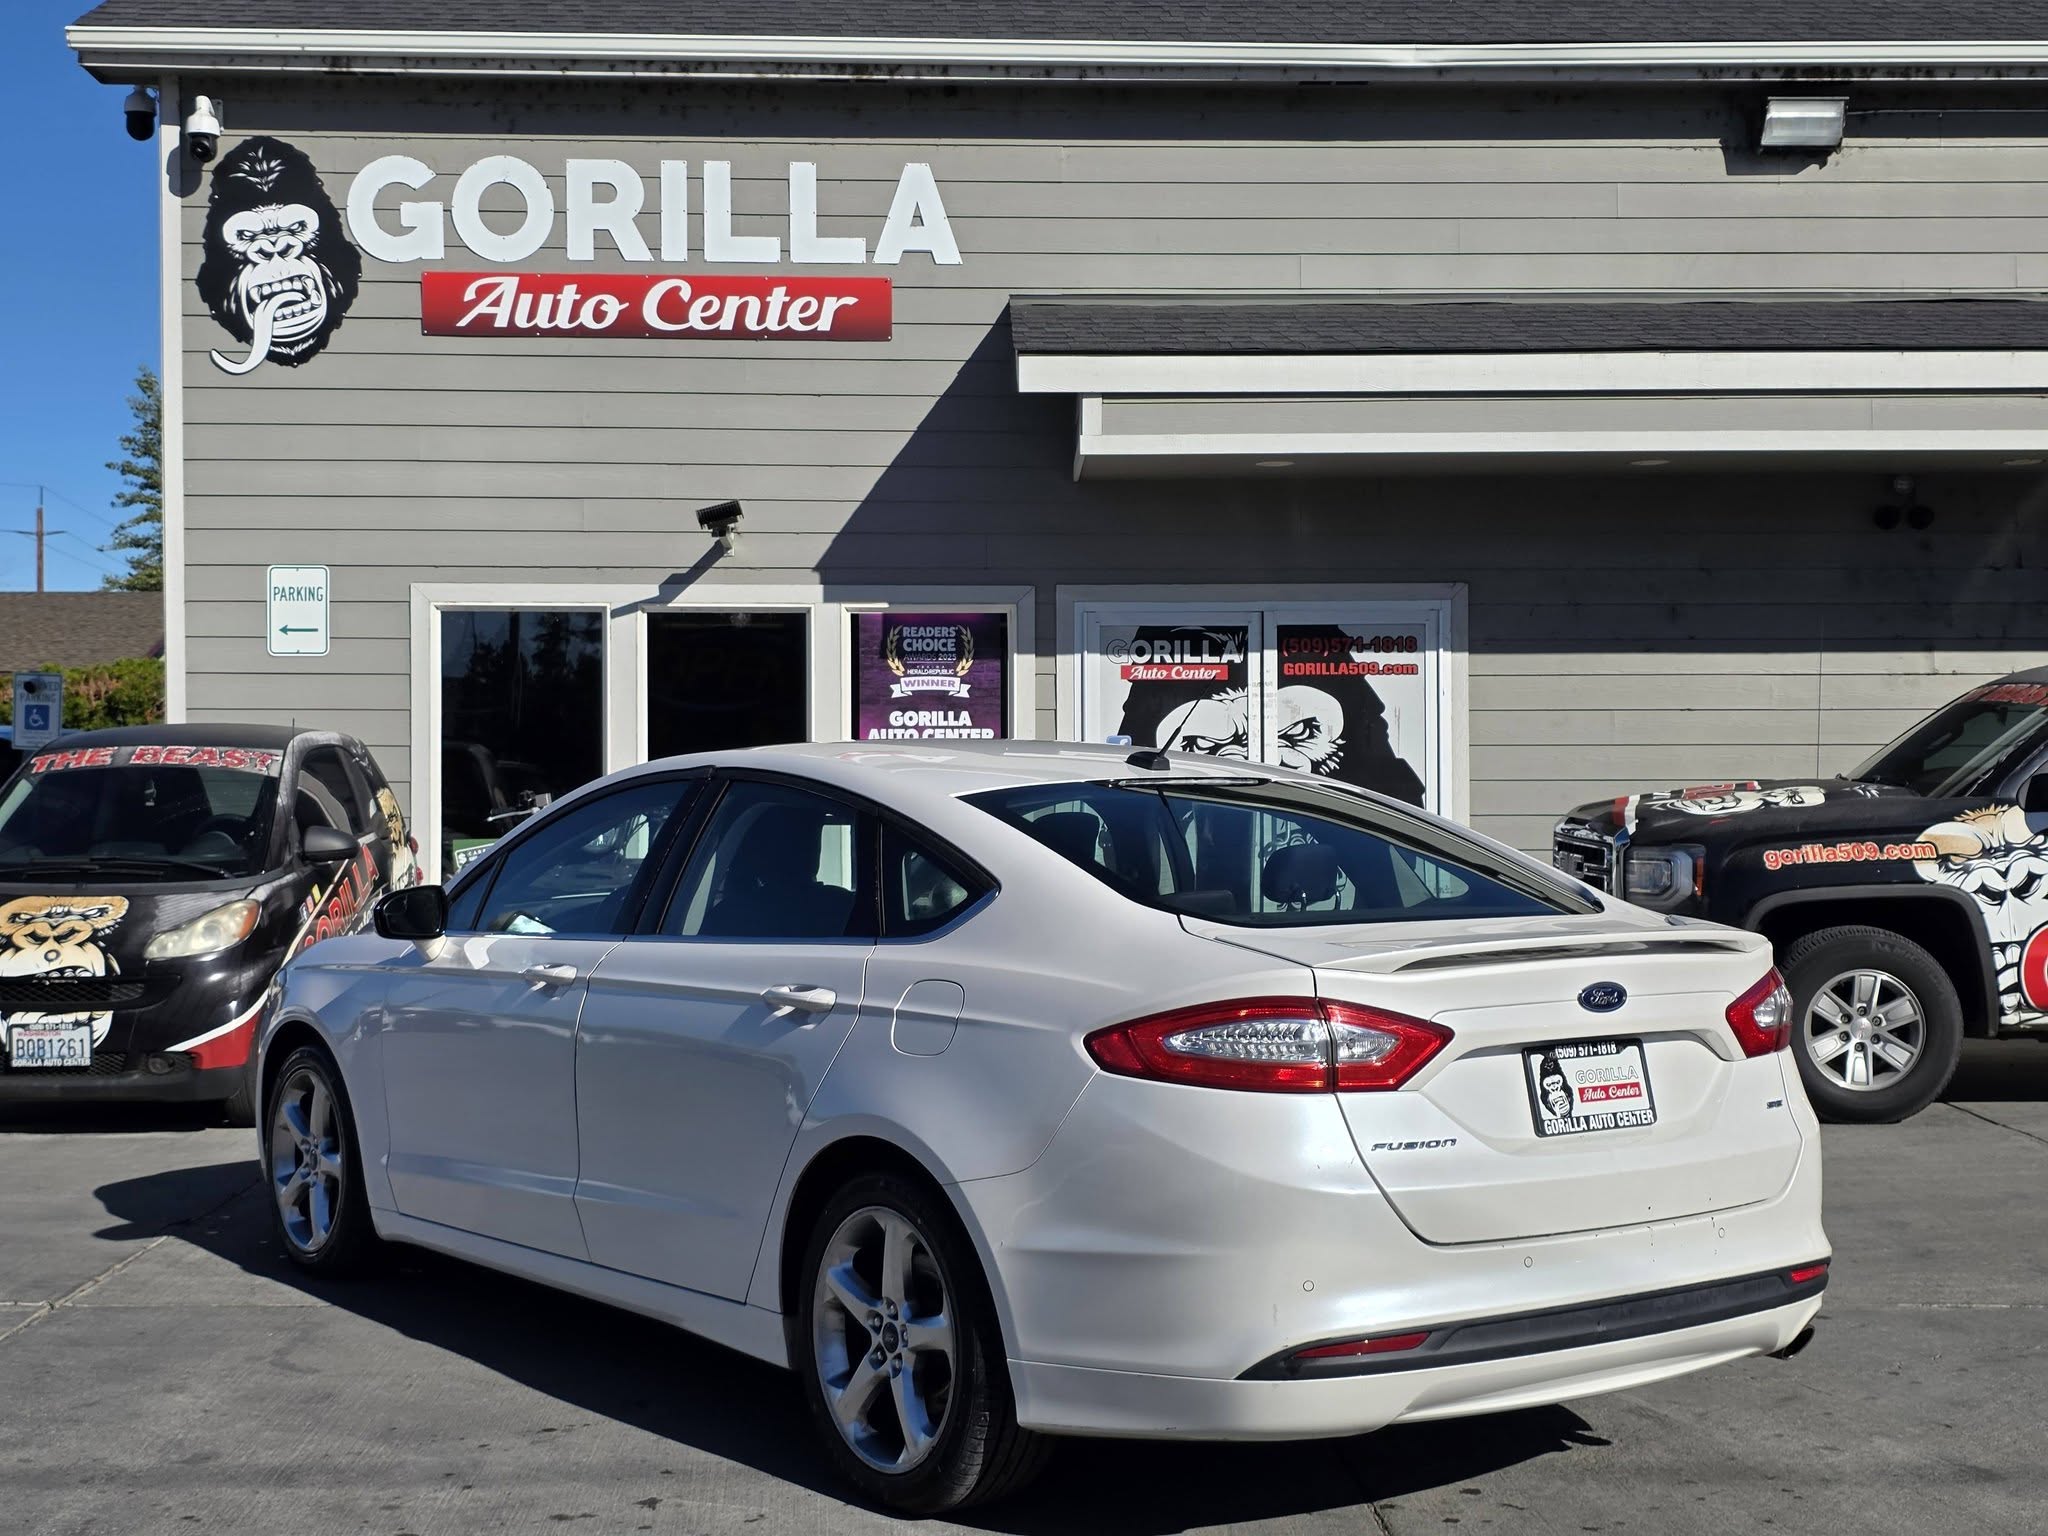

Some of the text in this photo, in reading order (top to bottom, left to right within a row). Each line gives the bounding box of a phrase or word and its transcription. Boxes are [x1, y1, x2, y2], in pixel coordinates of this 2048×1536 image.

[346, 155, 963, 265] GORILLA
[455, 275, 860, 333] Auto Center
[273, 586, 324, 602] PARKING
[903, 626, 958, 638] READERS'
[903, 638, 956, 652] CHOICE
[1106, 638, 1242, 664] GORILLA
[1282, 636, 1418, 657] (509)571-1818
[903, 653, 957, 661] AWARDS 2025
[1130, 665, 1221, 680] Auto Center
[1283, 661, 1419, 676] GORILLA509.com
[903, 679, 956, 688] WINNER
[889, 710, 973, 727] GORILLA
[868, 728, 995, 740] AUTO CENTER
[31, 745, 281, 774] THE BEAST
[1764, 841, 1938, 870] gorilla509.com
[1555, 1041, 1617, 1059] (509) 571-1818
[12, 1058, 91, 1067] GORILLA AUTO CENTER
[1575, 1066, 1639, 1084] GORILLA
[1582, 1084, 1641, 1101] Auto Center
[1589, 1112, 1615, 1129] AUTO
[1616, 1109, 1655, 1127] CENTER
[1371, 1138, 1457, 1152] FUSION
